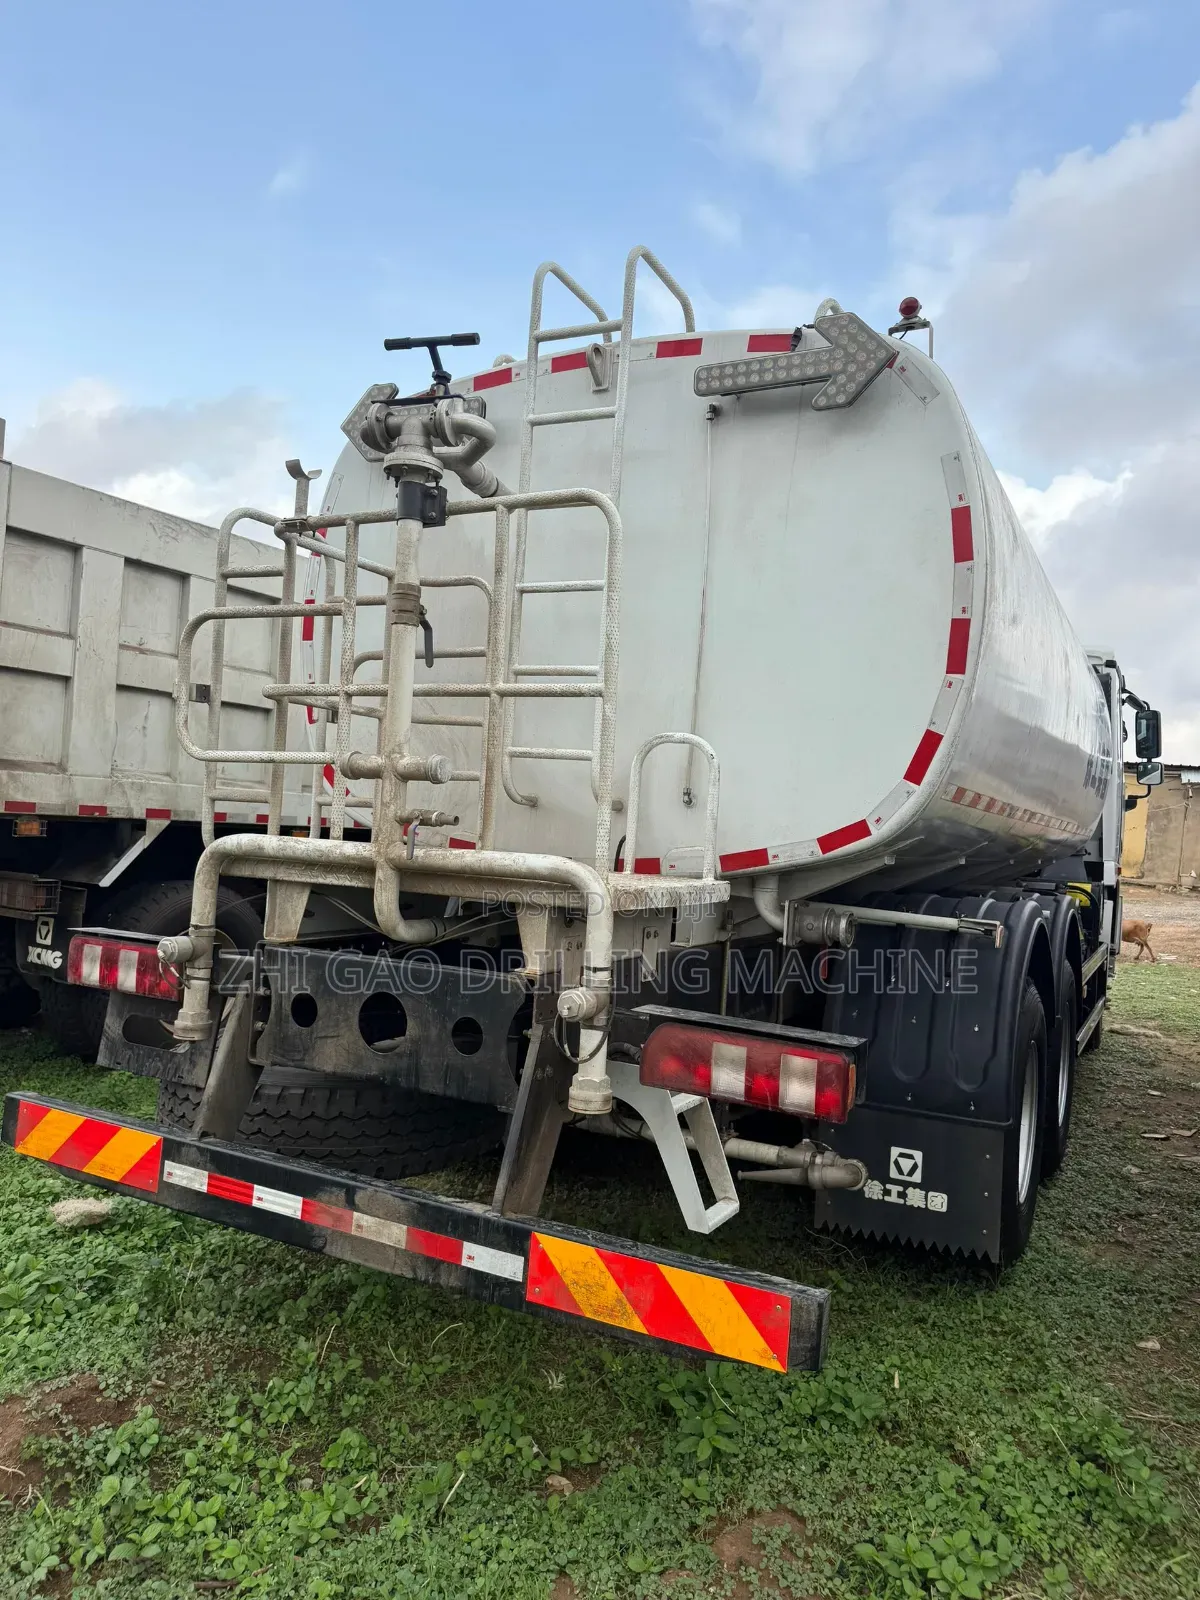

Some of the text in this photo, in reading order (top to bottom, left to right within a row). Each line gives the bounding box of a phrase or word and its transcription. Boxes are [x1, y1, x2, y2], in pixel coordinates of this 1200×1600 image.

[27, 945, 63, 969] XCMG
[863, 1179, 948, 1213] 徐工集团
[465, 1254, 475, 1262] 3M
